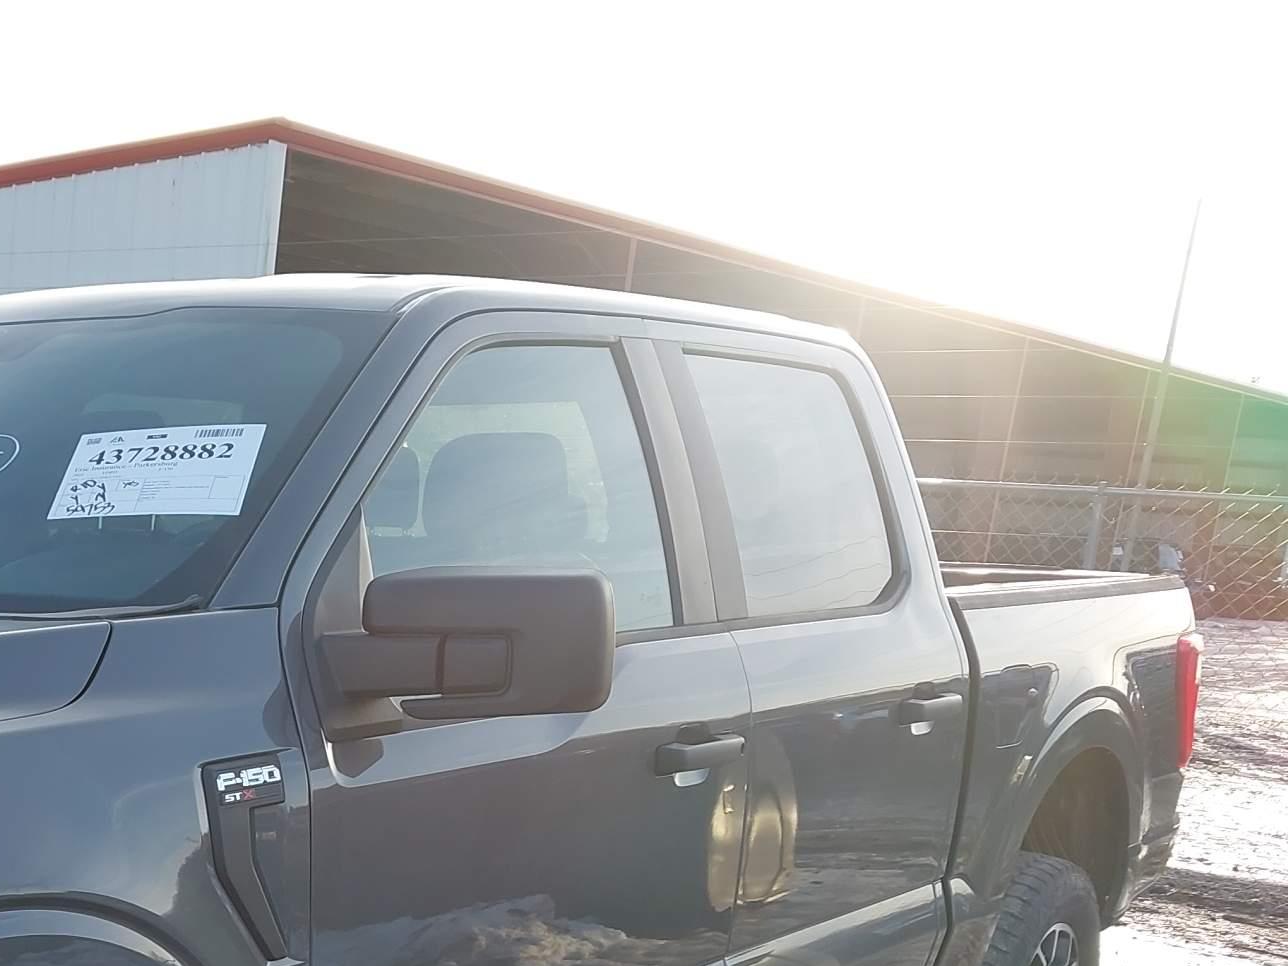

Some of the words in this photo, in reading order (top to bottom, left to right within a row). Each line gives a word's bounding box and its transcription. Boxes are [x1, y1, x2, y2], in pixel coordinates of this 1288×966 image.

[88, 443, 234, 466] 43728882
[217, 765, 281, 791] F-150
[224, 788, 256, 803] STX
